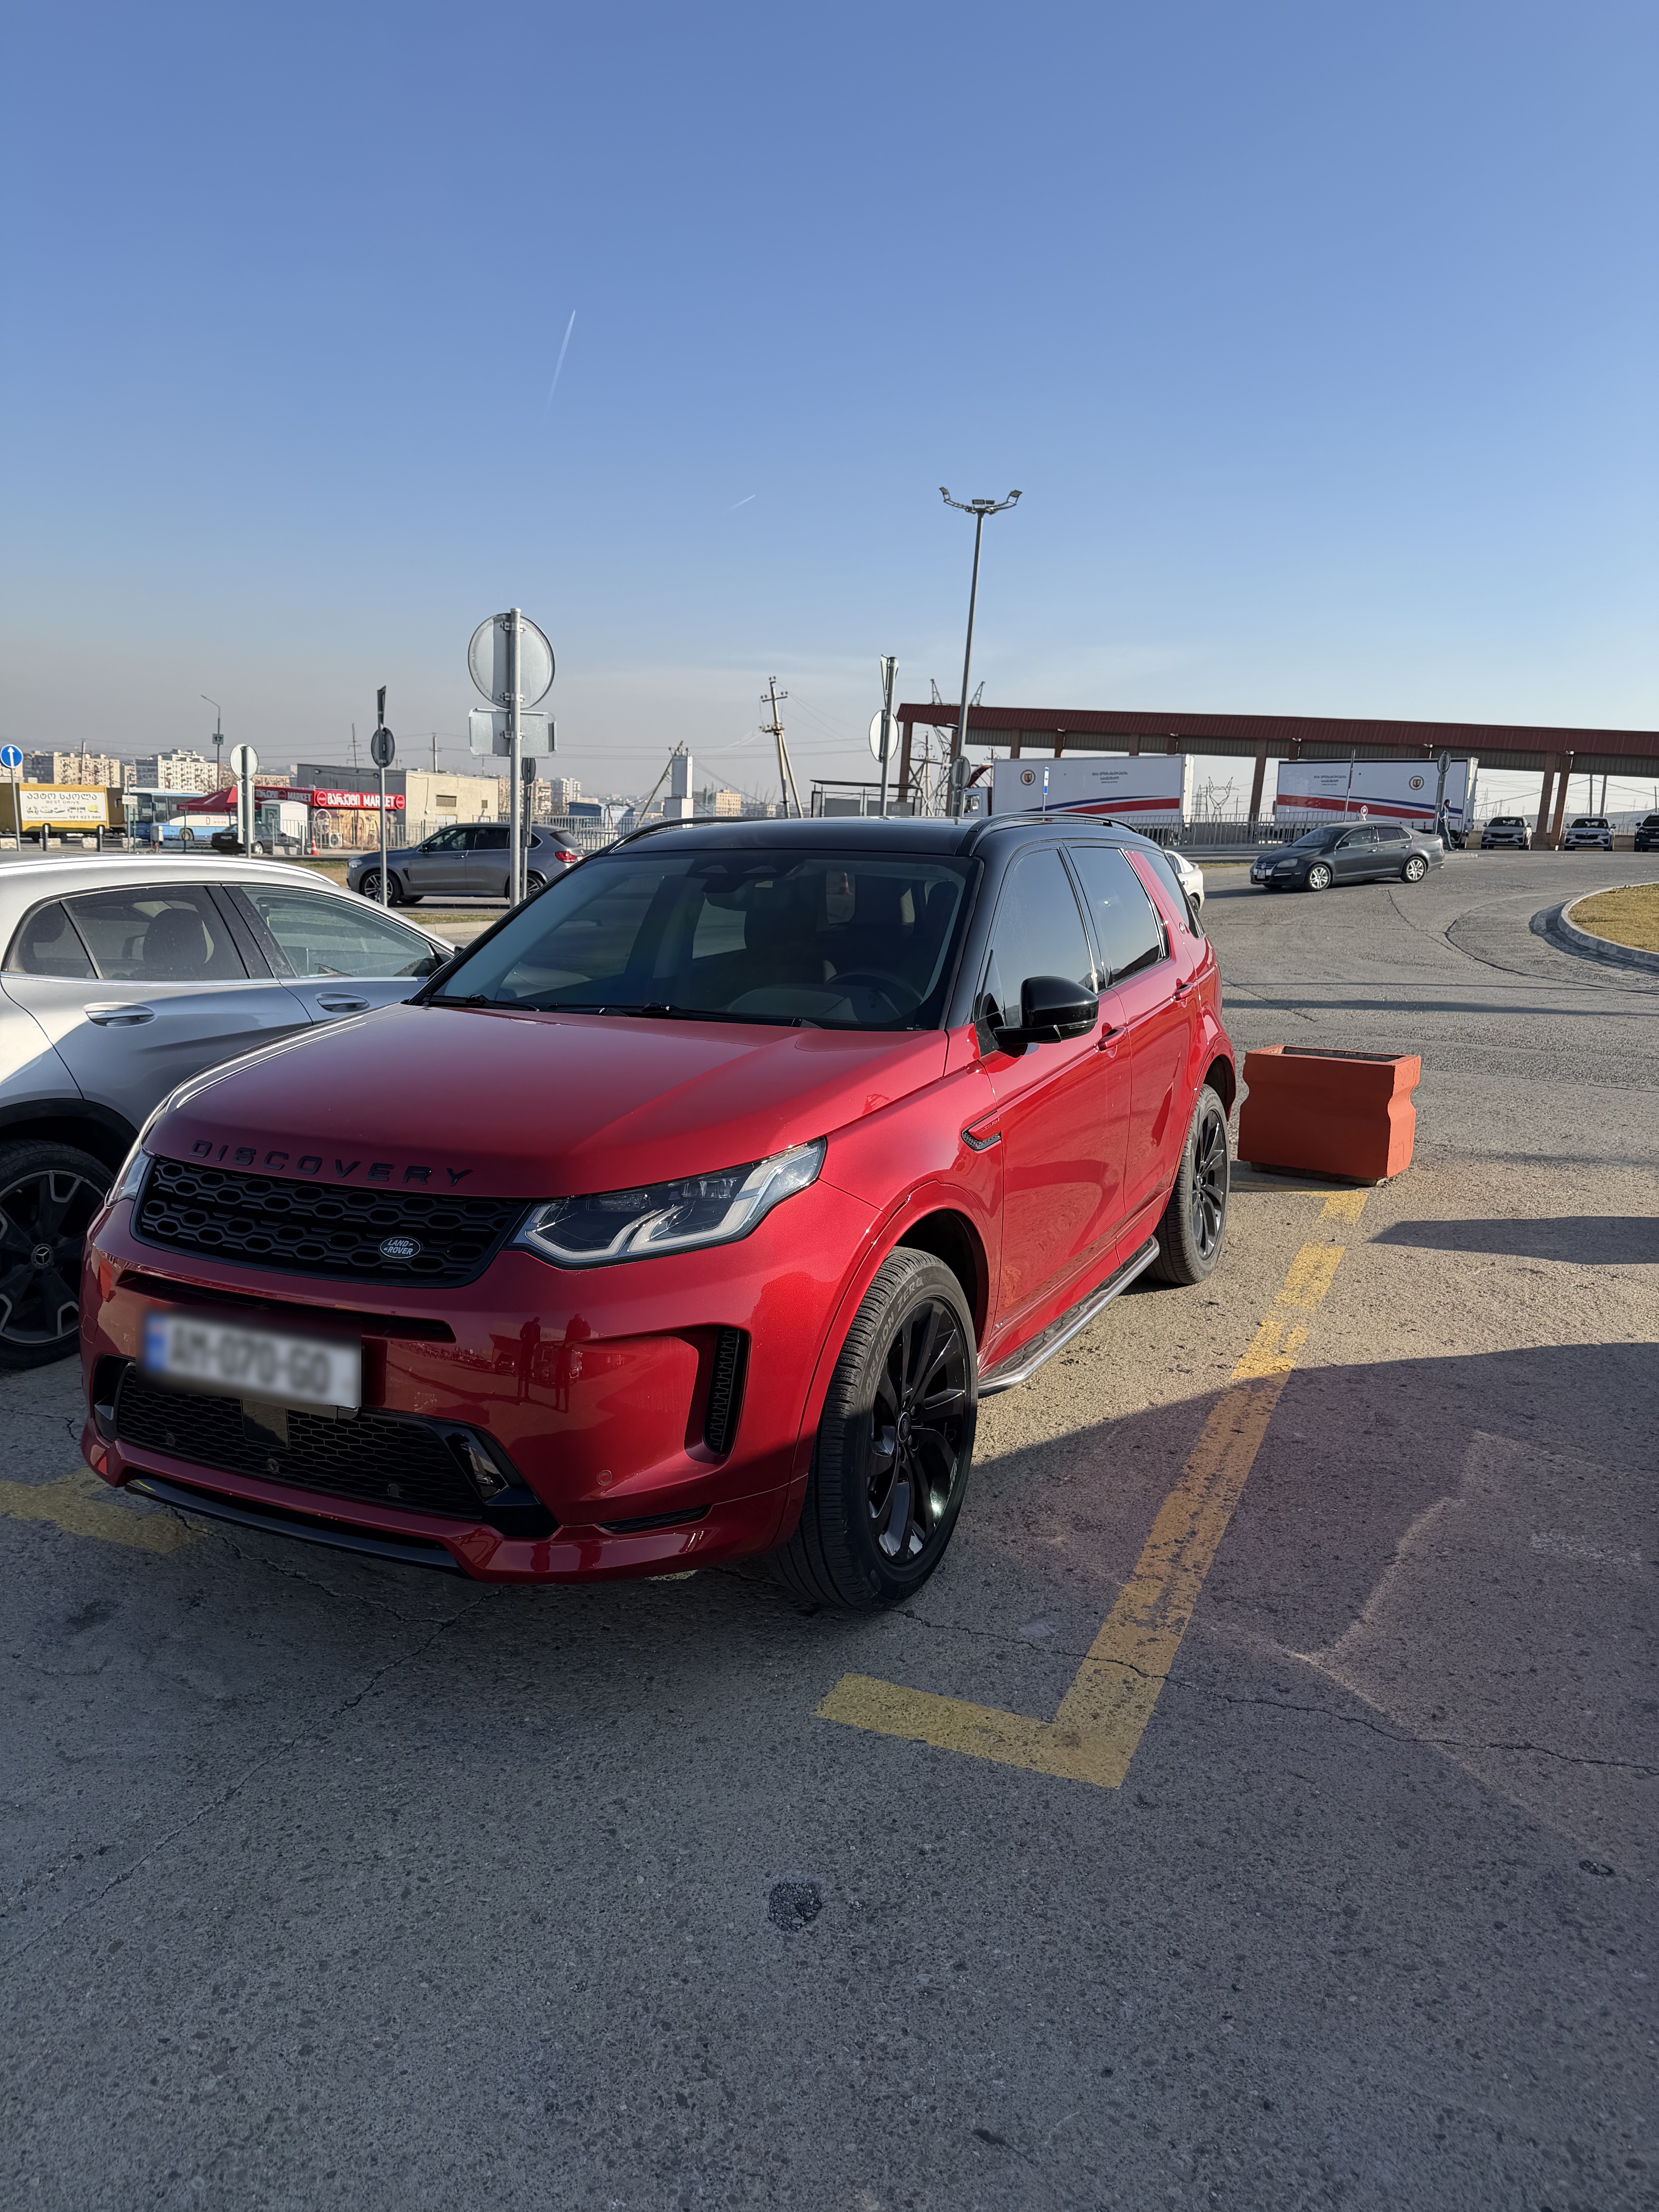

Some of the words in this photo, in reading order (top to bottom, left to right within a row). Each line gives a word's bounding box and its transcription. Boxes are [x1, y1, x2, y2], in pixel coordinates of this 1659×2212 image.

[287, 792, 312, 802] MARKET
[363, 795, 395, 807] MARET
[189, 1139, 474, 1187] DISCOVERY
[387, 1246, 413, 1255] ROVER
